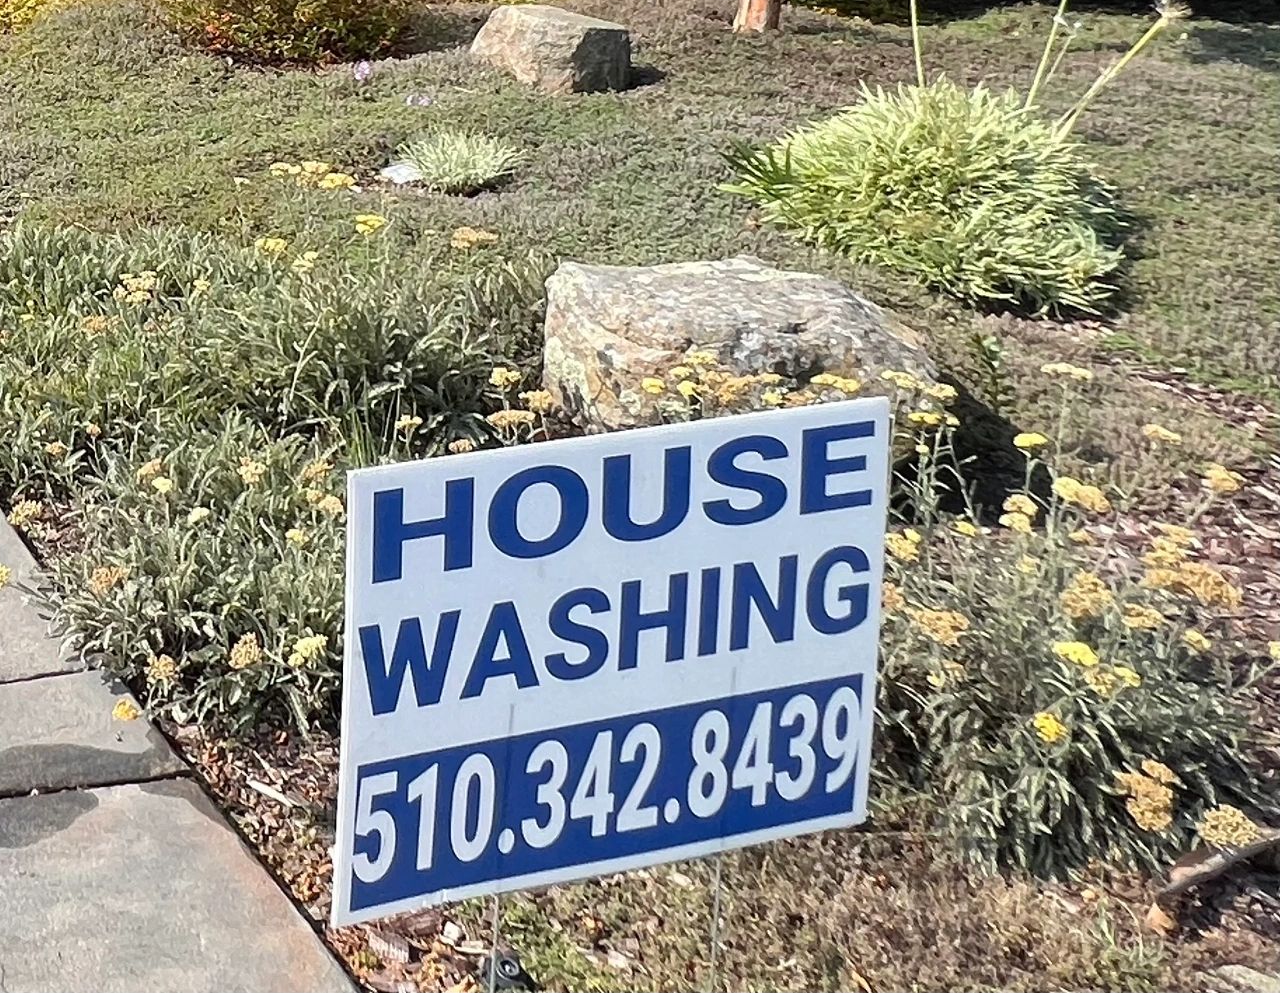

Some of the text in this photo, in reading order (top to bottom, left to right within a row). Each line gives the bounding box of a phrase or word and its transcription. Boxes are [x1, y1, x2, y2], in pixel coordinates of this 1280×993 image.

[372, 420, 875, 584] HOUSE
[358, 545, 870, 716] WASHING
[351, 686, 861, 883] 510.342.8439
